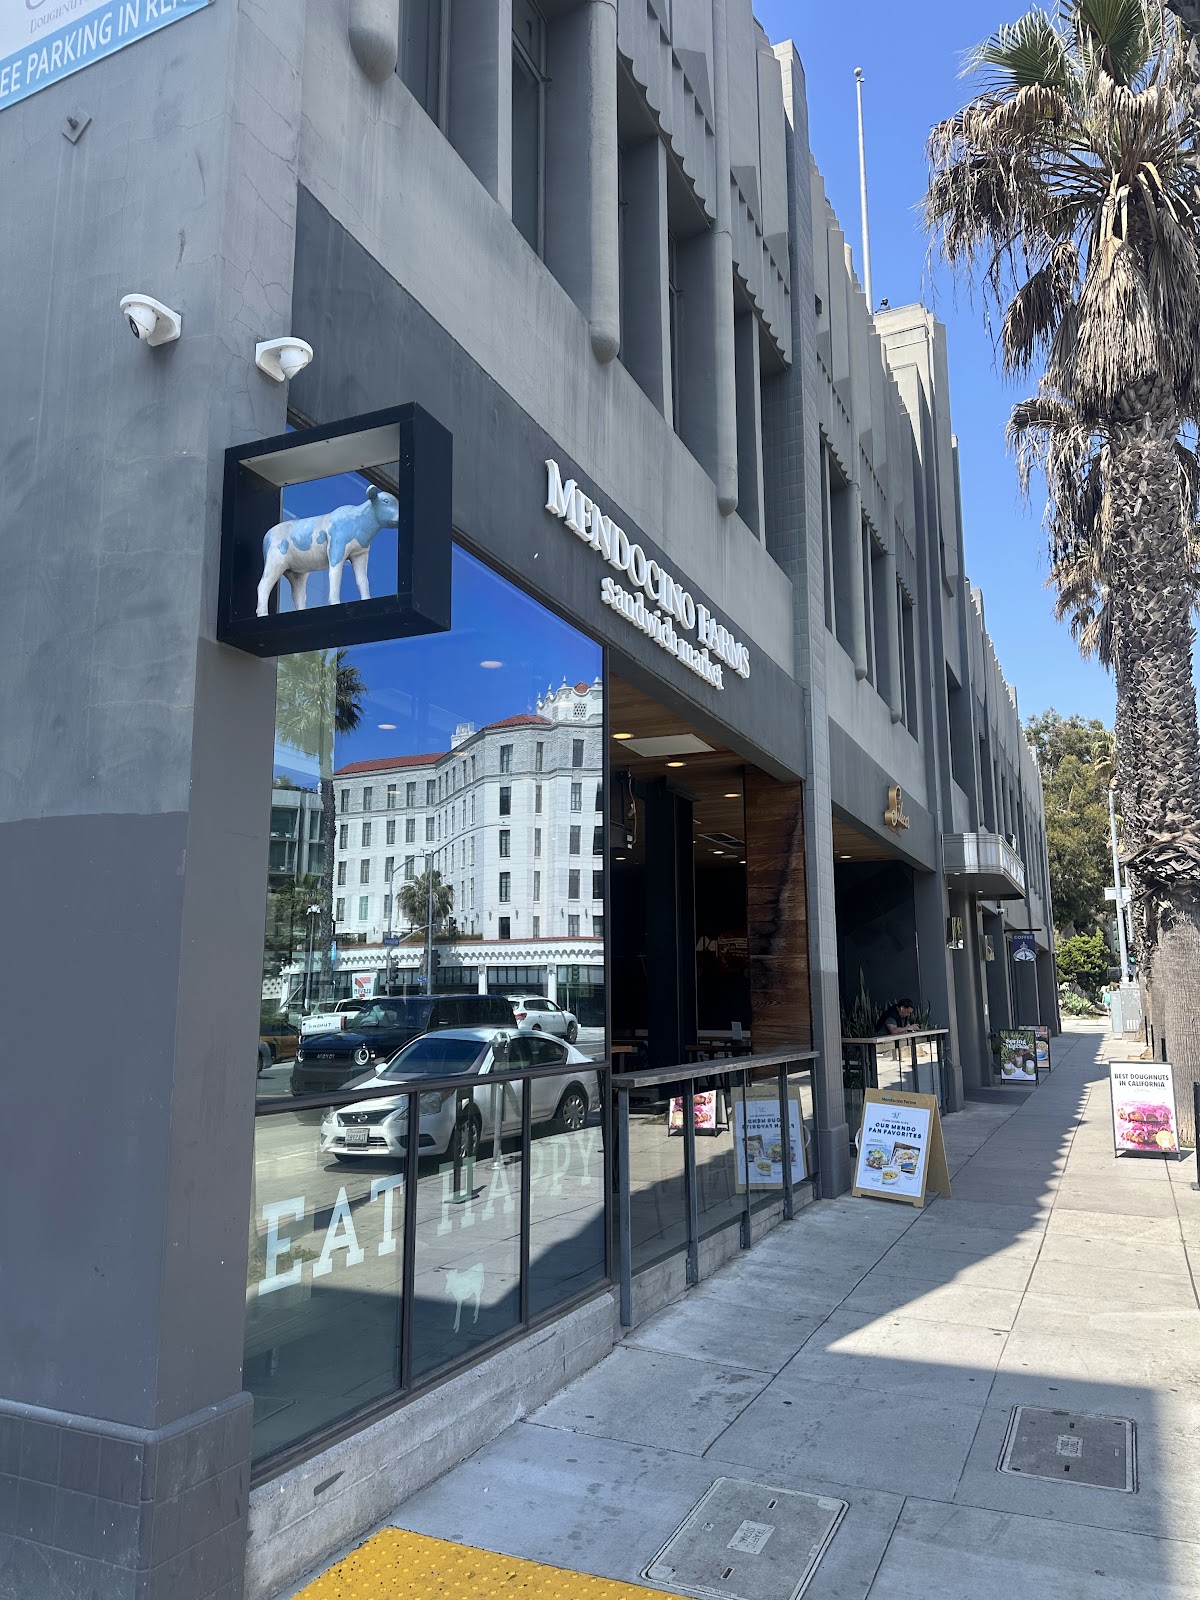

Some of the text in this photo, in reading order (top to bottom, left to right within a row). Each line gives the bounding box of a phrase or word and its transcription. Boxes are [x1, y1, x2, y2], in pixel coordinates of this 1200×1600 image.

[26, 12, 113, 85] PARKING
[118, 0, 140, 37] IN
[545, 458, 751, 680] MENDOCINO FARMS
[601, 576, 725, 691] sandwich market
[1128, 1080, 1166, 1088] CALIFORNIA
[1130, 1073, 1169, 1081] DOUGHNUTS
[883, 1129, 922, 1139] FAVORITES
[891, 1123, 917, 1132] MENDO
[258, 1173, 404, 1297] EAT
